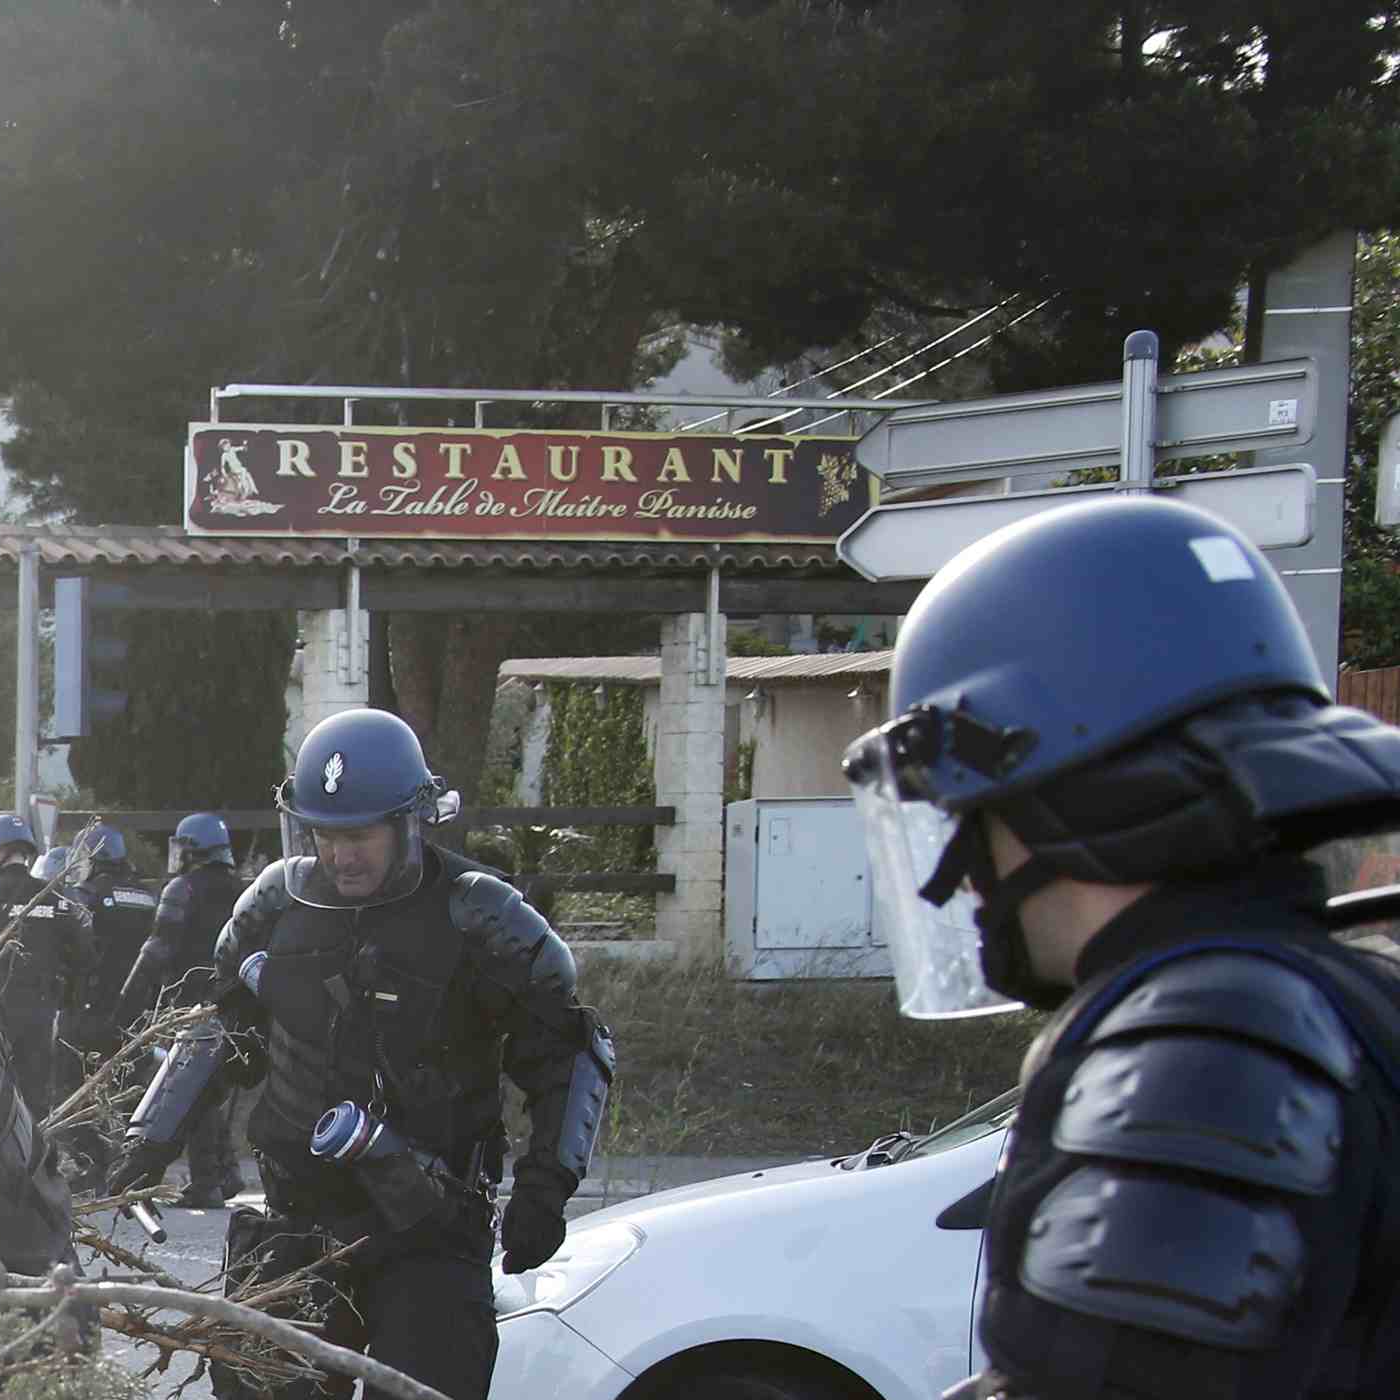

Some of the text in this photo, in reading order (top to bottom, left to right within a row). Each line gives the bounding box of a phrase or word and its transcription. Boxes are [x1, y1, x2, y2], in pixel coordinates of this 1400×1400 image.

[276, 440, 795, 484] RESTAURANT
[317, 478, 758, 520] La Table de Maître Panisse
